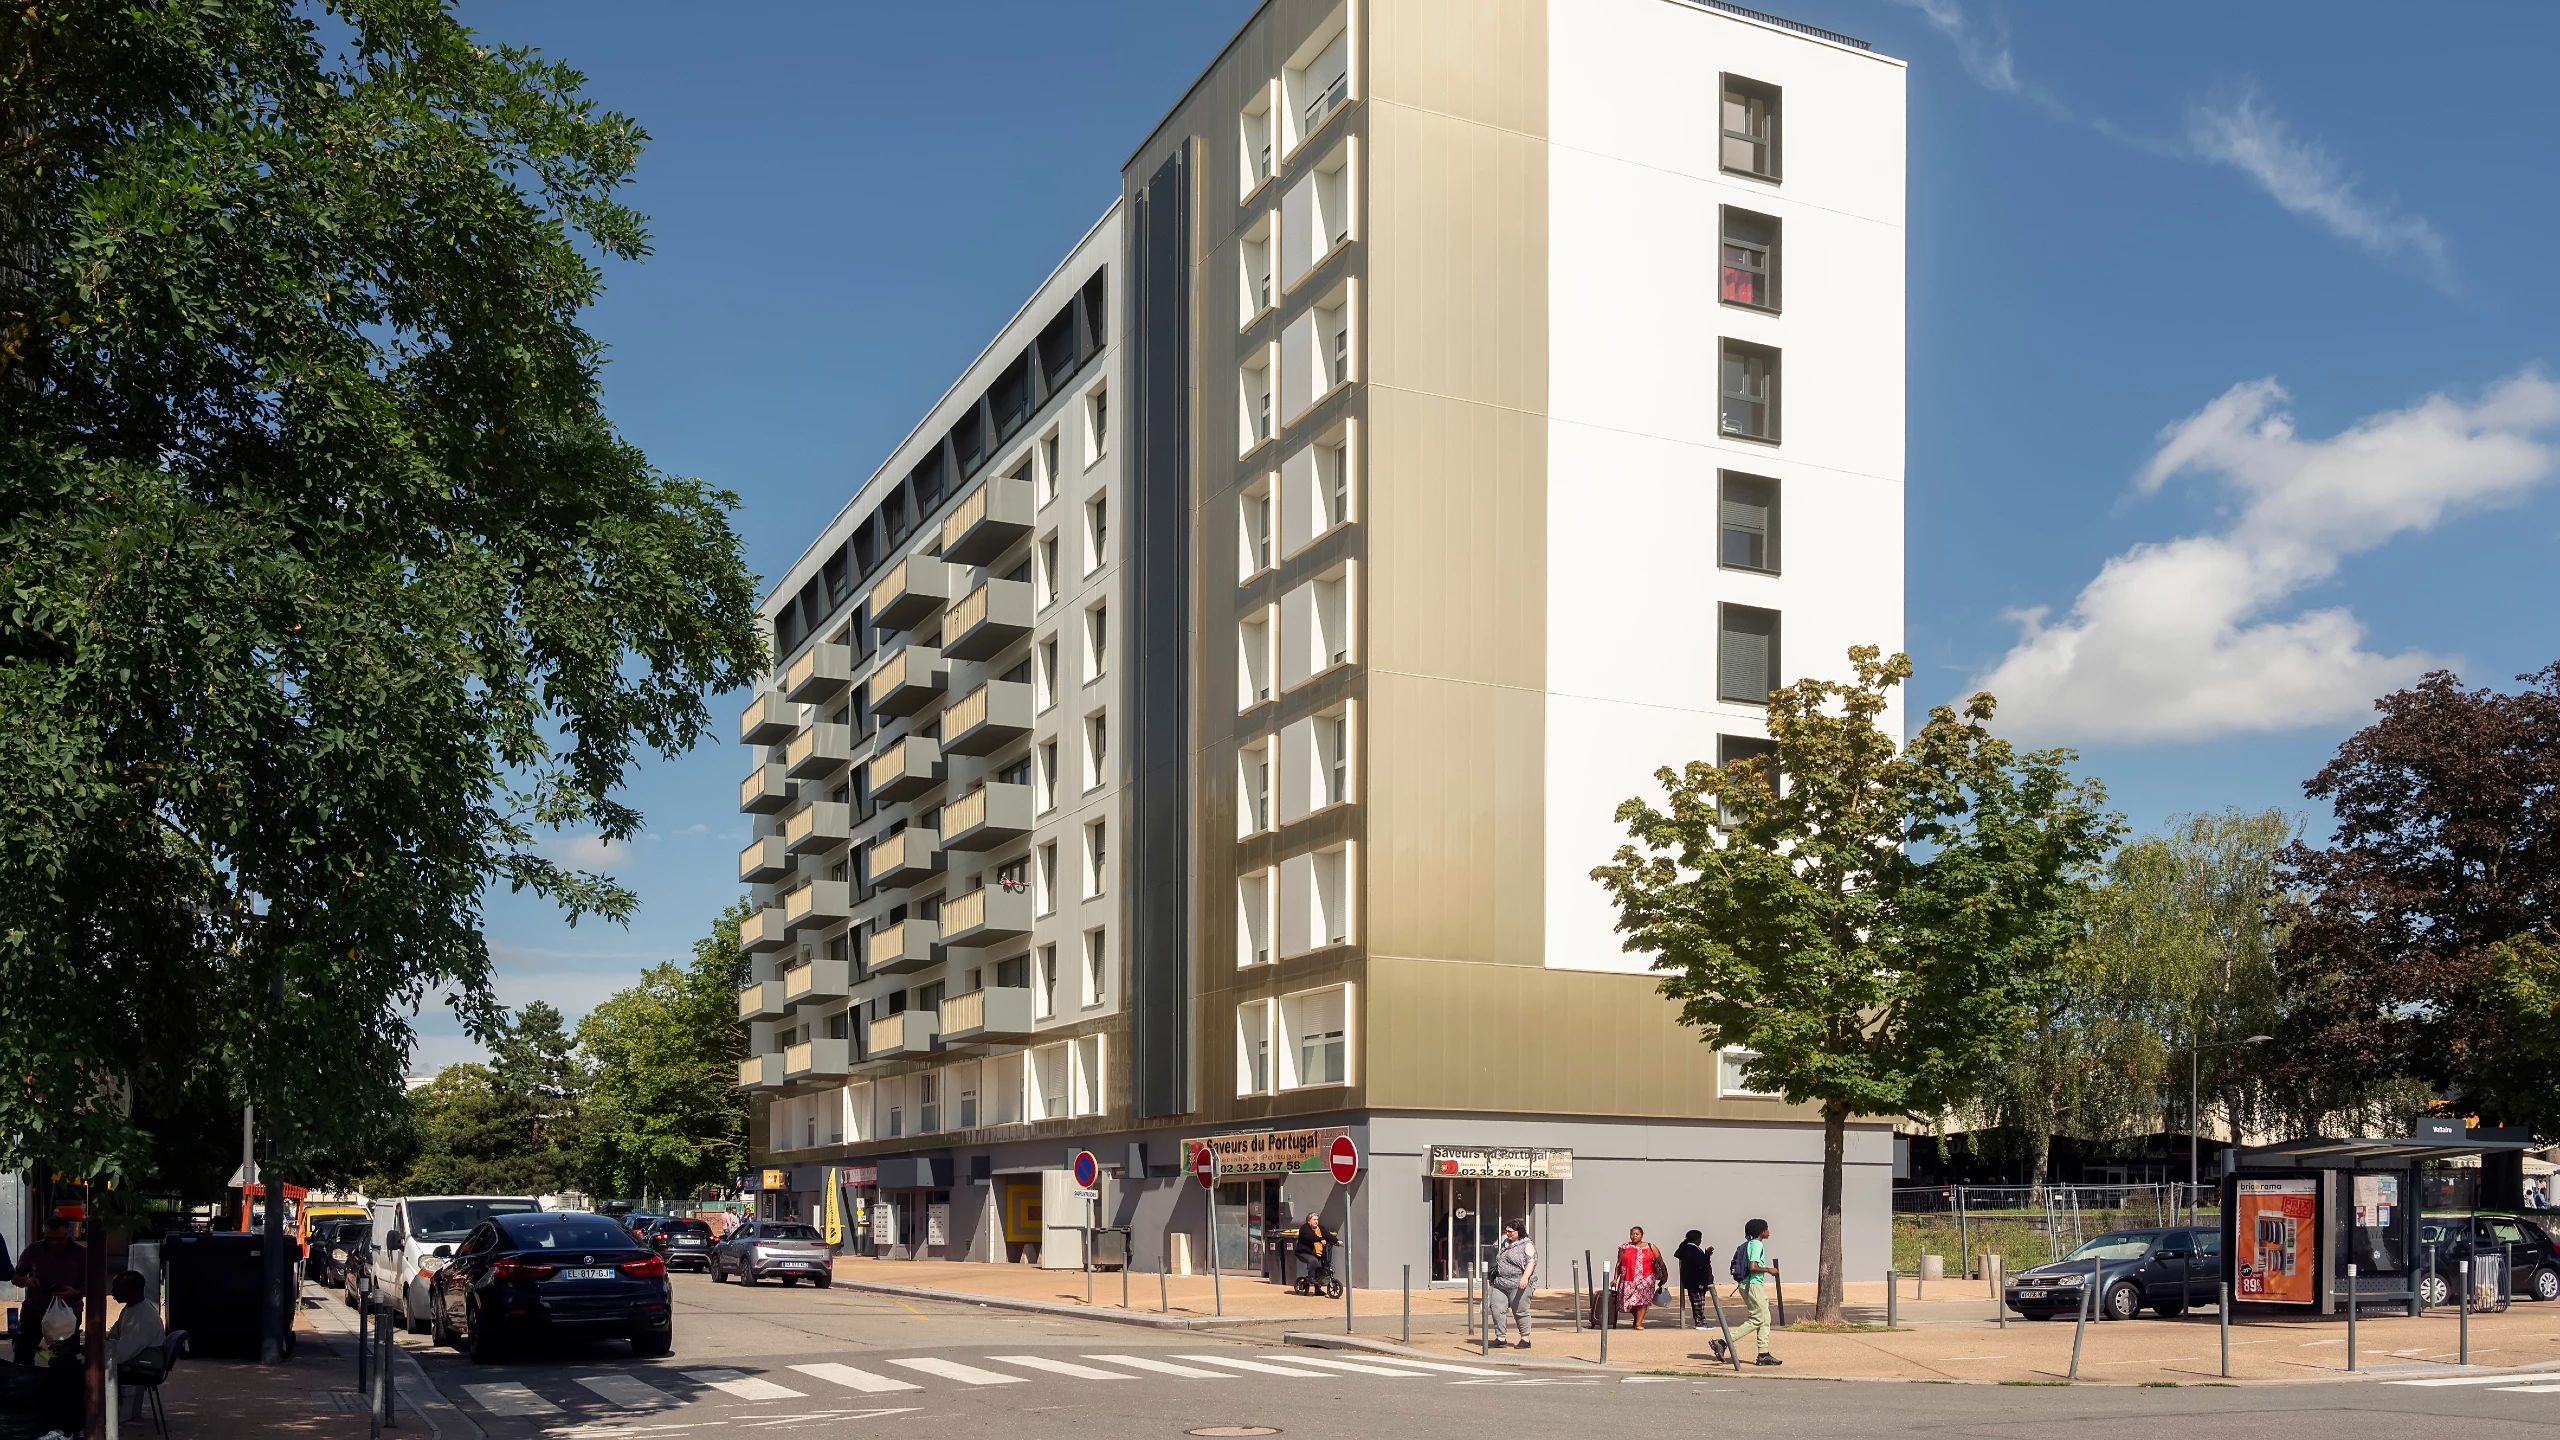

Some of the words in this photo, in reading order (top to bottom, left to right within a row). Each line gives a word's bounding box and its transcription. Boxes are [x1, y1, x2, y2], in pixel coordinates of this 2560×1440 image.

[1206, 1139, 1248, 1155] Saveurs
[1251, 1134, 1265, 1152] du
[1268, 1131, 1318, 1153] Portugal
[1434, 1147, 1480, 1159] Saveurs
[1220, 1164, 1234, 1173] 02
[1236, 1163, 1250, 1173] 32
[1252, 1162, 1266, 1172] 28
[1269, 1161, 1283, 1171] 07
[1286, 1160, 1301, 1171] 58
[1461, 1168, 1477, 1176] 02
[1497, 1169, 1511, 1177] 28
[1514, 1169, 1529, 1177] 07
[2284, 1199, 2311, 1210] PRIX
[2283, 1207, 2309, 1216] CHOC
